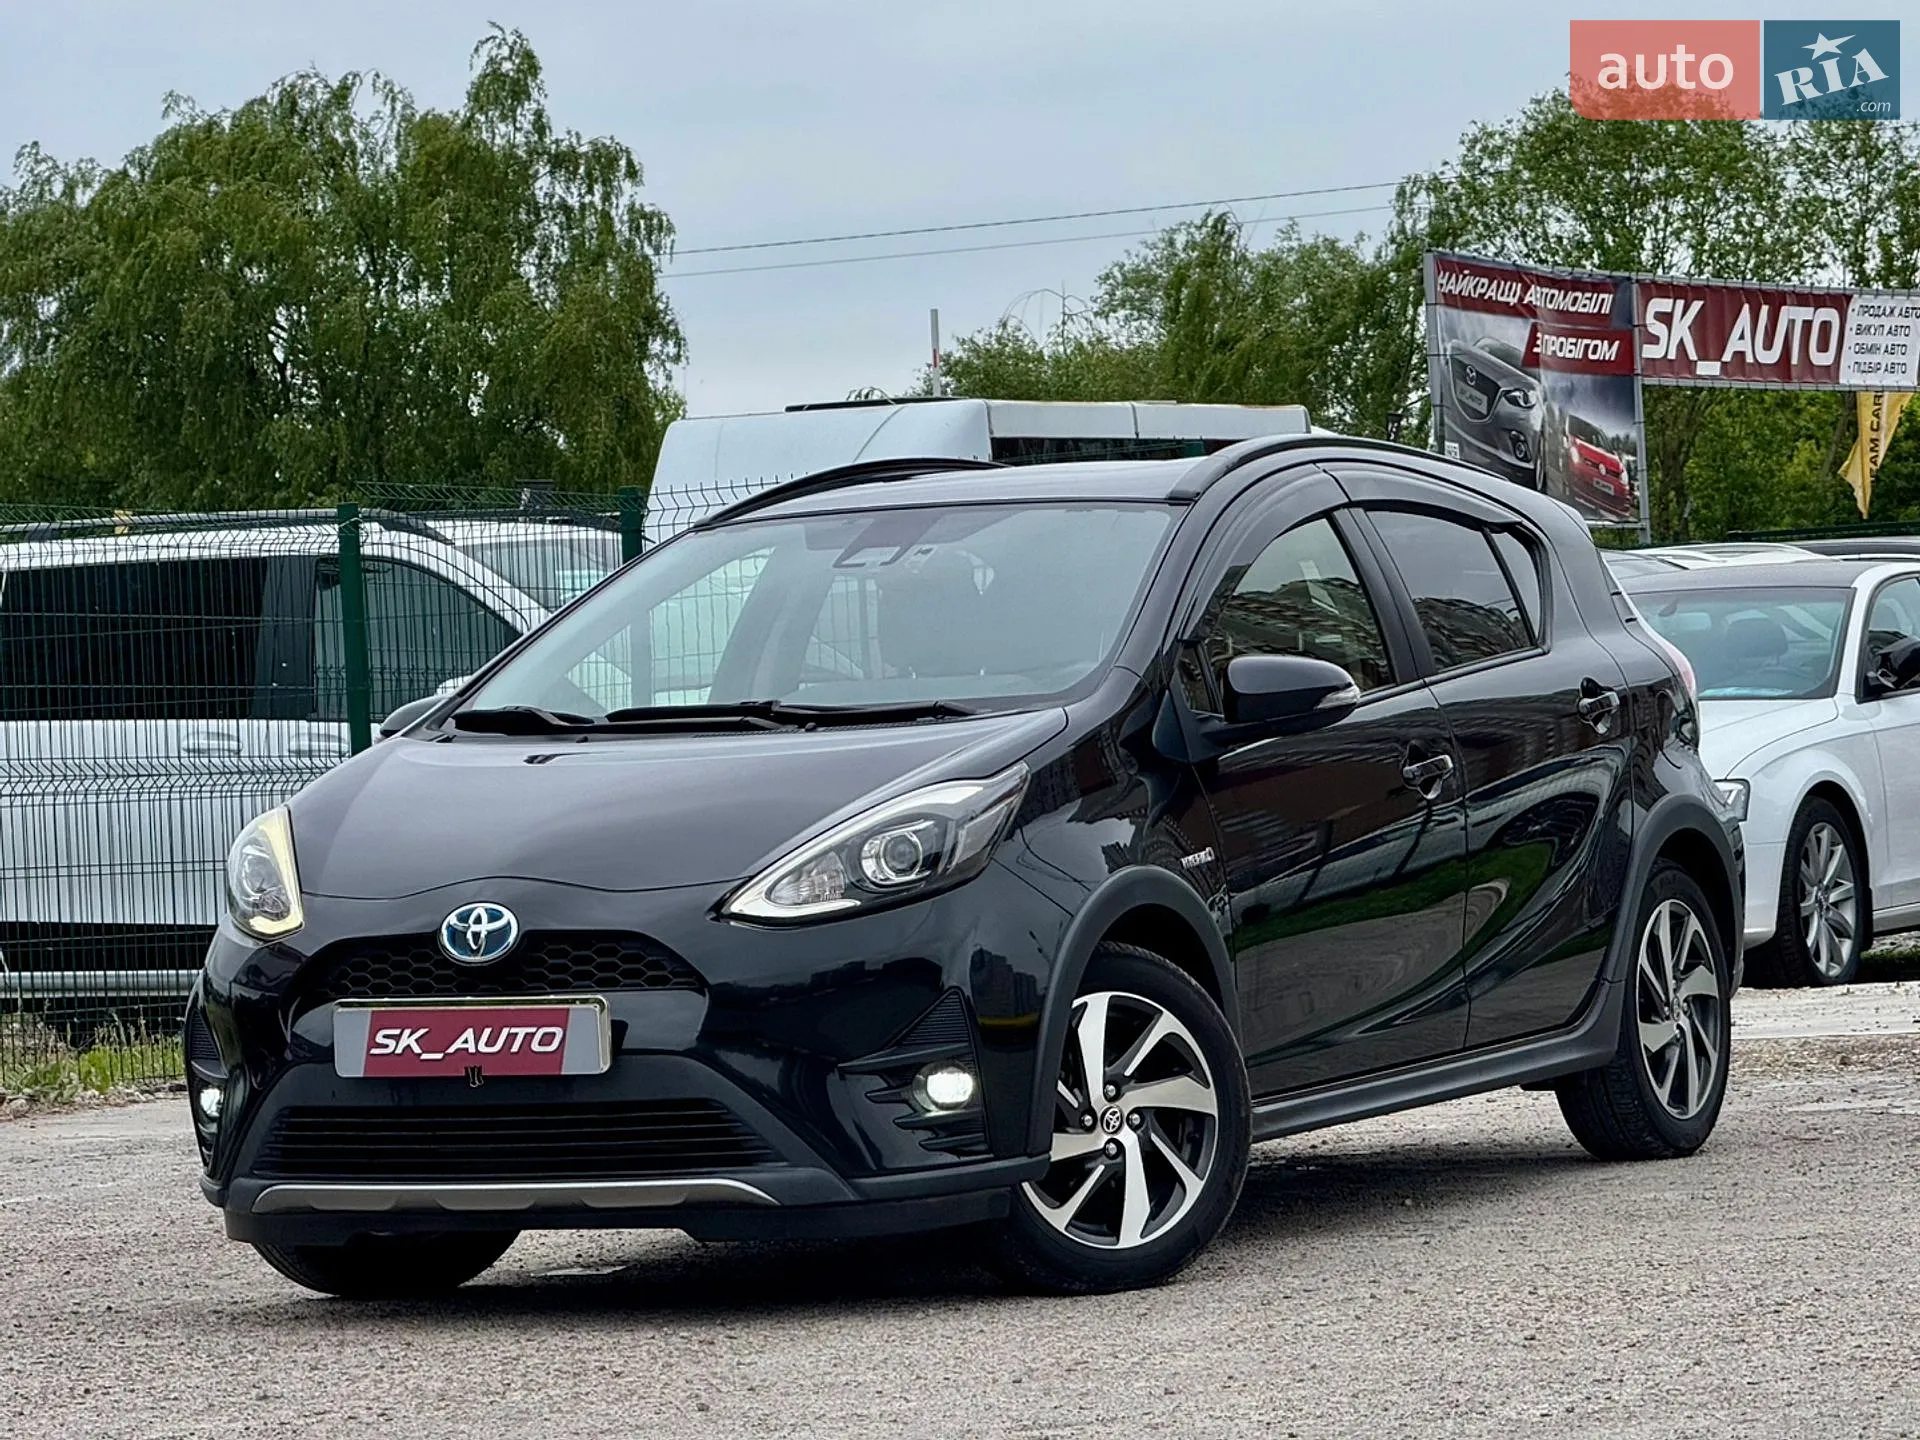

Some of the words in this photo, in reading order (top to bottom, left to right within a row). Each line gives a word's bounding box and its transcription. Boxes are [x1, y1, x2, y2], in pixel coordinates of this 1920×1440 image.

[1437, 269, 1521, 306] НАЙКРАЩІ
[1857, 304, 1896, 319] ПРОДАЖ
[1898, 306, 1920, 319] АВТО
[1641, 297, 1841, 376] SK_AUTO
[1855, 323, 1884, 336] ВИКУП
[1886, 324, 1911, 337] АВТО
[1853, 342, 1881, 355] ОБМІН
[1883, 343, 1908, 356] АВТО
[1852, 361, 1881, 375] ПІДБІР
[1883, 362, 1907, 375] АВТО
[369, 1026, 564, 1060] SK_AUTO
